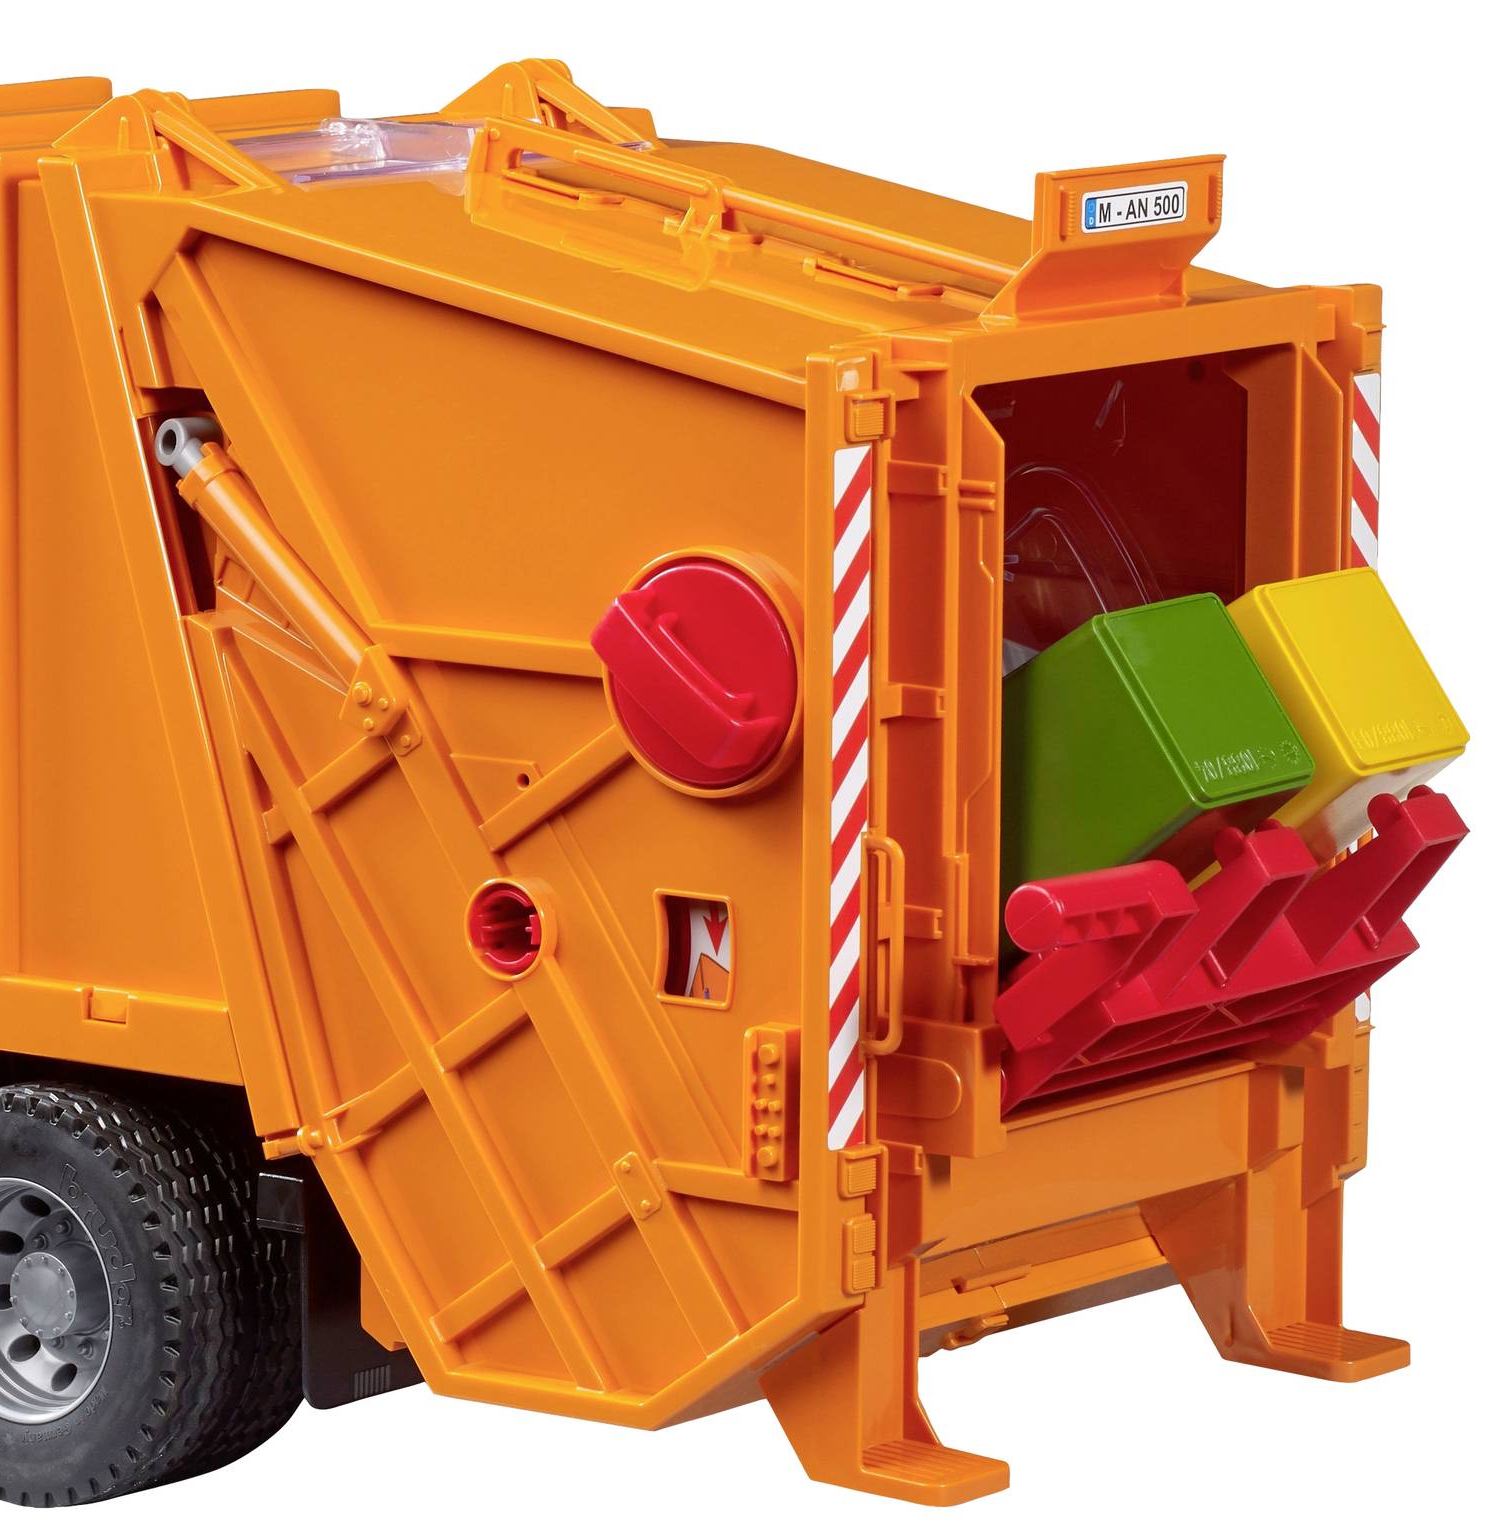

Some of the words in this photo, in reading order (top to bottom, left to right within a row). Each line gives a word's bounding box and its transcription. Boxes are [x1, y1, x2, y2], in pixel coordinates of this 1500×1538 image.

[1099, 202, 1112, 223] M
[1125, 197, 1148, 220] AN
[1153, 193, 1180, 216] 500
[60, 1162, 137, 1330] bruder
